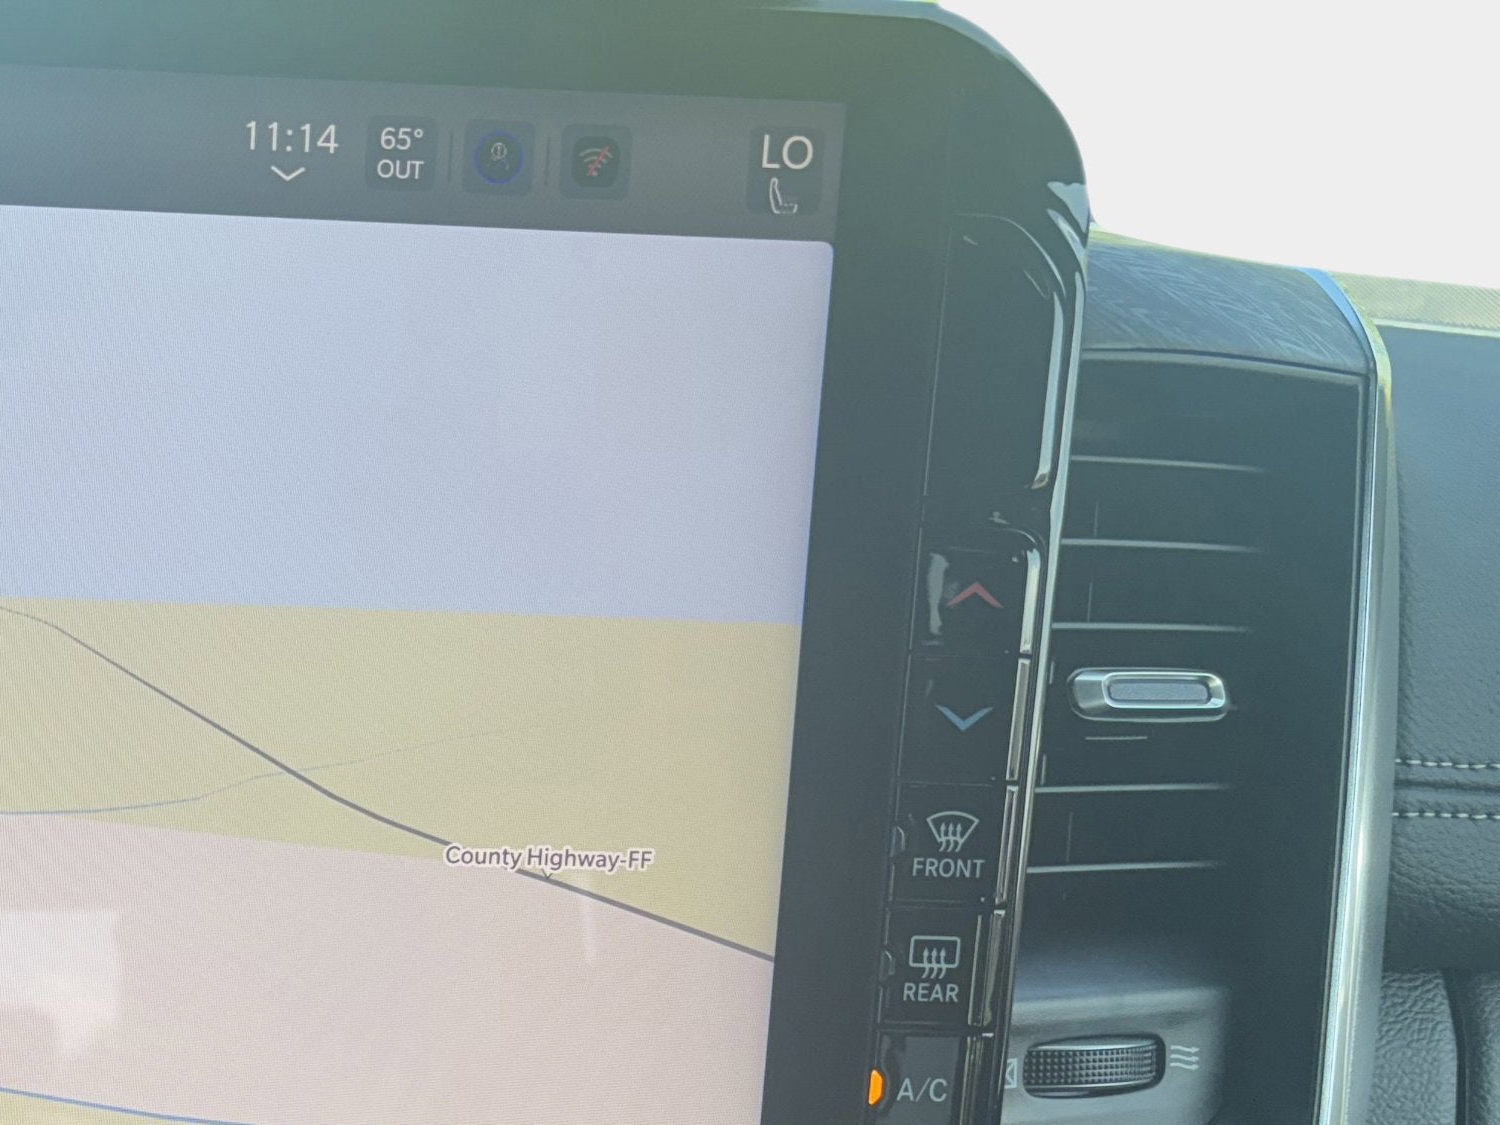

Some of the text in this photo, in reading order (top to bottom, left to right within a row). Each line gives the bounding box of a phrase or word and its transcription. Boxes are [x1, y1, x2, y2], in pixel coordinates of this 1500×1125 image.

[245, 121, 340, 155] 11:14
[761, 134, 814, 171] LO
[376, 160, 425, 181] OUT
[445, 845, 654, 873] County Highway-FF
[911, 858, 985, 878] FRONT
[902, 983, 959, 1002] REAR
[895, 1078, 948, 1102] A/C
